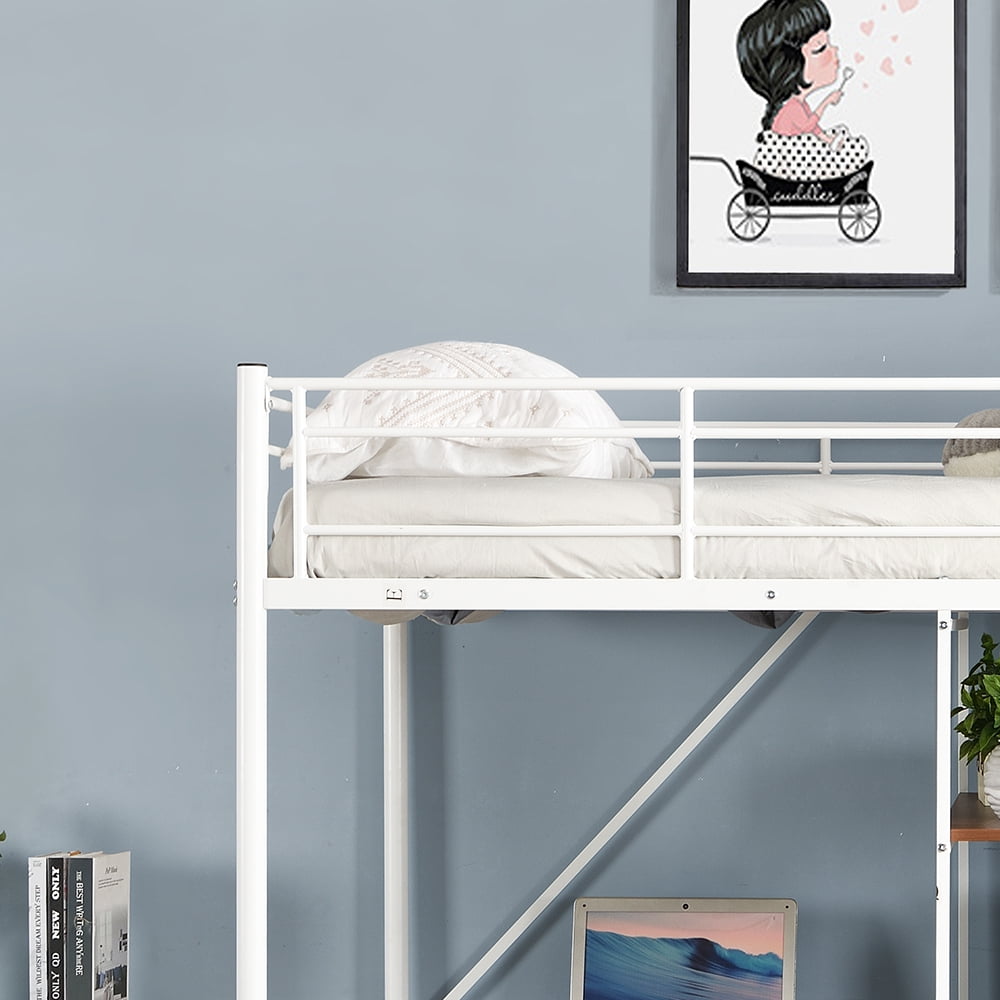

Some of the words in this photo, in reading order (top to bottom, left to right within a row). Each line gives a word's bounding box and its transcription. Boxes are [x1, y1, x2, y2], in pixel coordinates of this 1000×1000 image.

[51, 866, 60, 900] ONLY
[75, 882, 84, 904] BEST
[51, 910, 60, 940] NEW
[51, 952, 60, 968] QD
[51, 971, 60, 1000] ONLY
